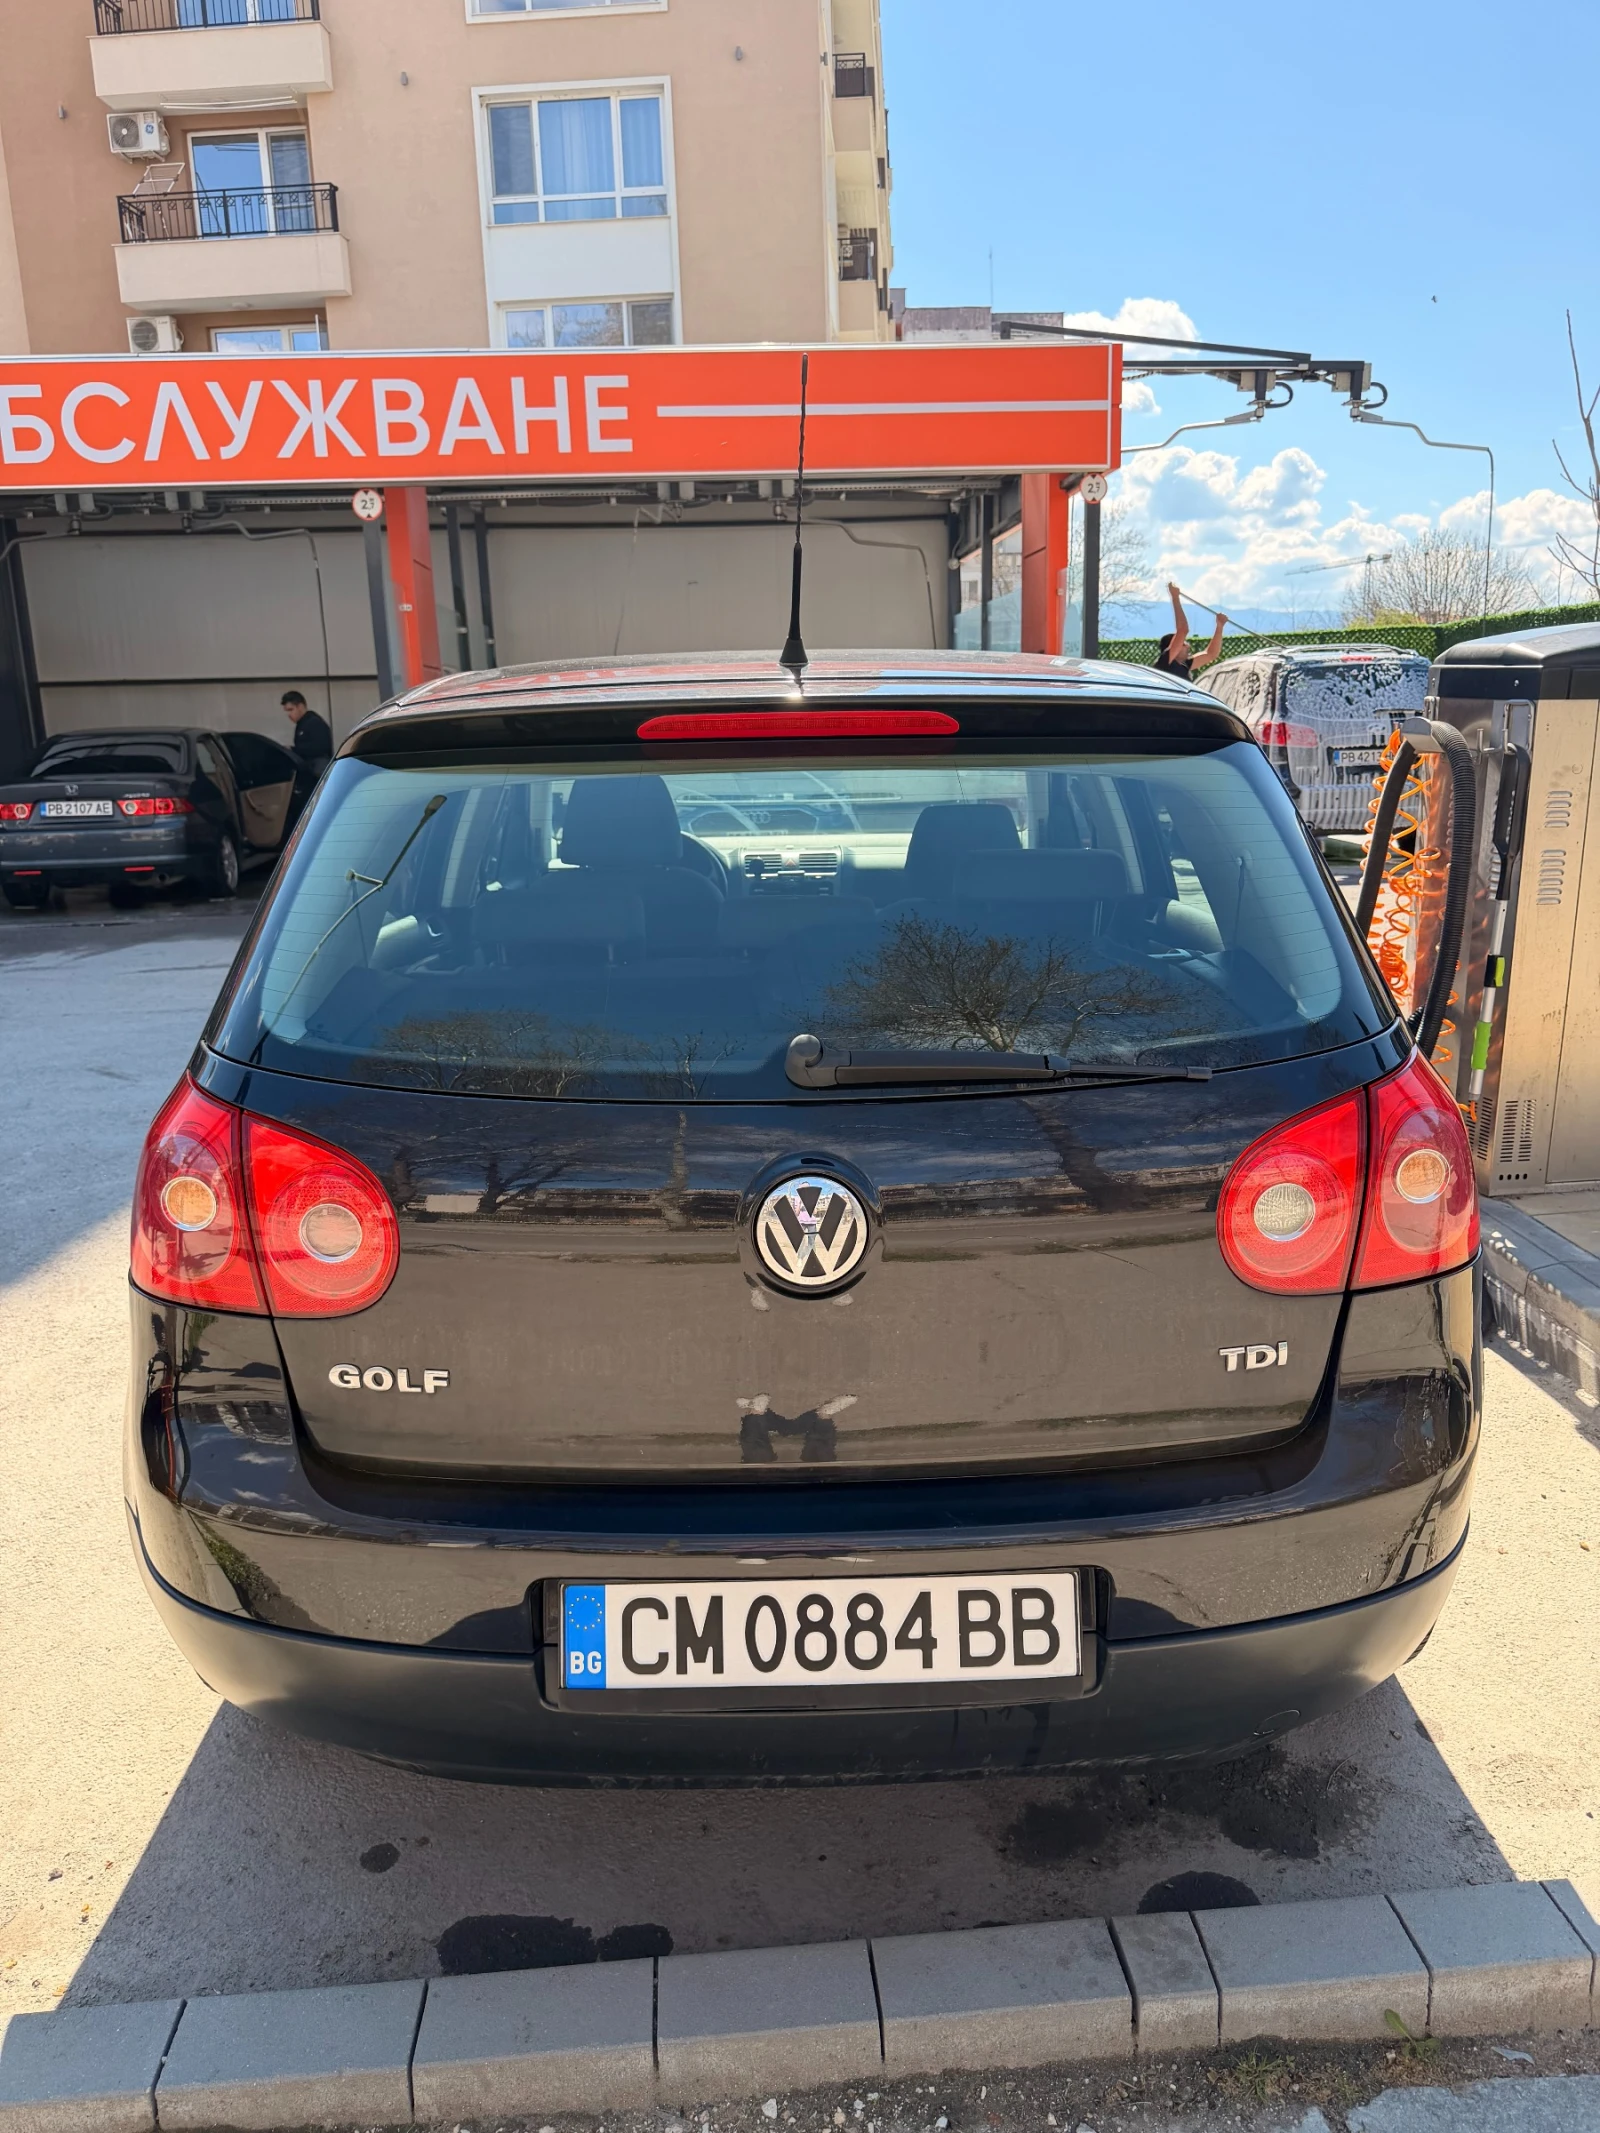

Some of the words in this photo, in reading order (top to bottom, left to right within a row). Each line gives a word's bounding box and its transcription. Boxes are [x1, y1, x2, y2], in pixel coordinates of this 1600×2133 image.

[0, 375, 634, 464] БСЛУЖВАНЕ
[1341, 752, 1355, 763] PB
[48, 803, 63, 815] PB
[65, 803, 93, 815] 2107
[96, 802, 111, 814] AE
[328, 1363, 450, 1394] GOLF
[621, 1596, 724, 1675] CM
[744, 1591, 938, 1674] 0884
[958, 1588, 1060, 1668] BB
[570, 1651, 602, 1675] BG
